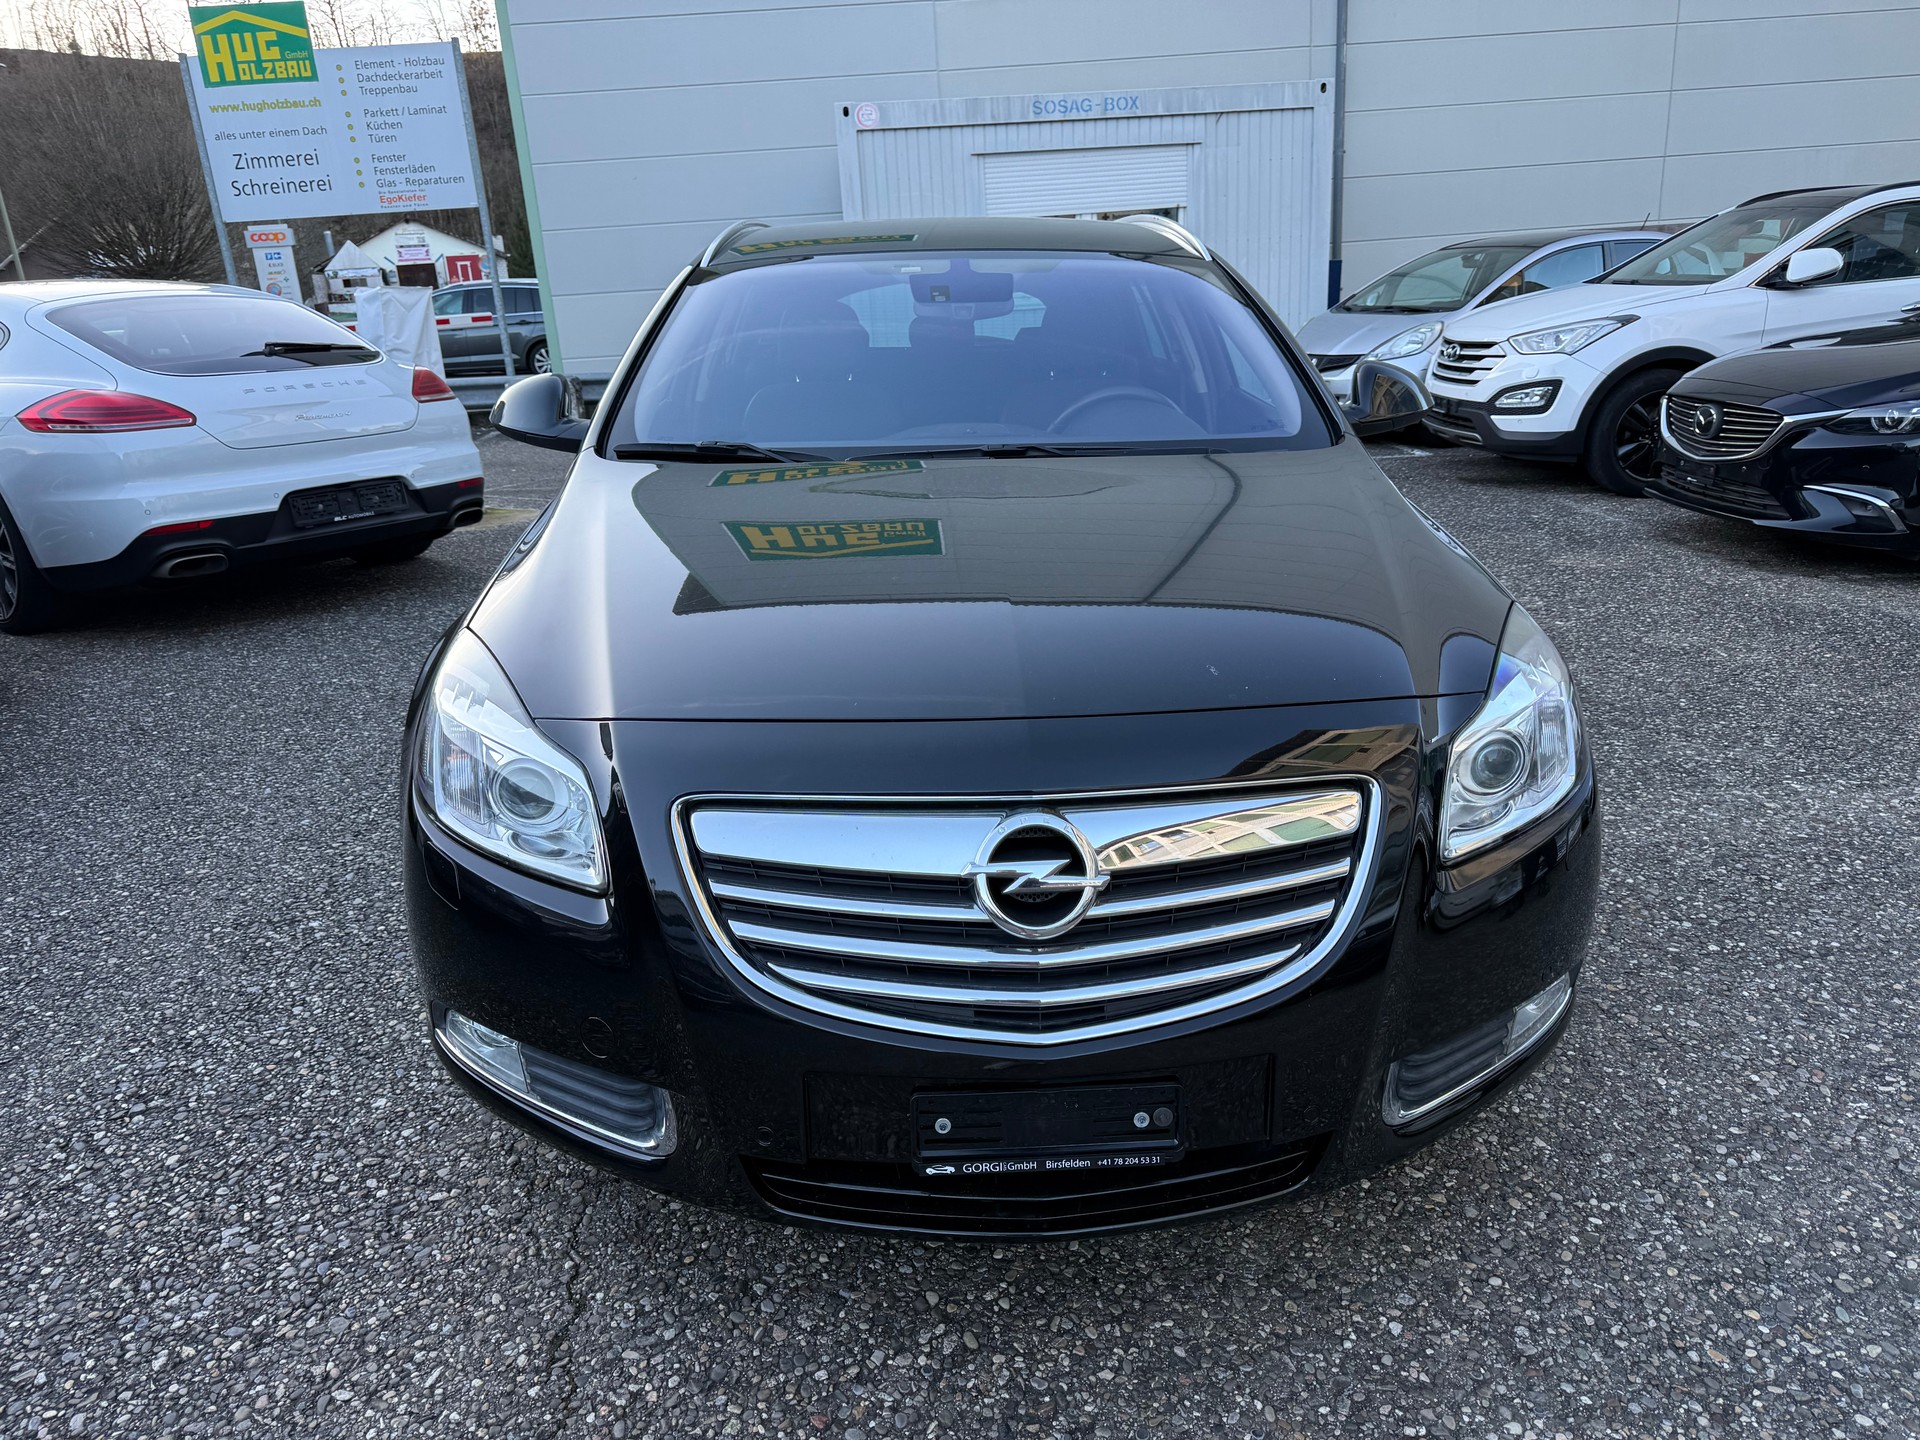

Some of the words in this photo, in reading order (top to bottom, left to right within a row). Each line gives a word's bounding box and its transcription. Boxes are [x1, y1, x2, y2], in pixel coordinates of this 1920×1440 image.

[201, 31, 281, 82] HUG
[285, 51, 308, 59] GmbH
[354, 59, 395, 70] Element
[403, 56, 445, 67] Holzbau
[356, 69, 443, 83] Dachdeckerarbeit
[359, 84, 418, 97] Treppenbau
[208, 97, 321, 113] www.hugholzbau.ch
[363, 108, 400, 118] Parkett
[407, 105, 447, 116] Laminat
[365, 120, 403, 131] Küchen
[214, 131, 237, 141] alles
[239, 130, 266, 140] unter
[269, 128, 300, 138] einem
[302, 125, 328, 136] Dach
[368, 133, 397, 143] Türen
[232, 148, 320, 170] Zimmerei
[371, 153, 406, 163] Fenster
[373, 164, 436, 176] Fensterläden
[231, 174, 333, 197] Schreinerei
[376, 178, 397, 188] Glas
[405, 175, 465, 187] Reparaturen
[379, 193, 427, 205] EgoKiefer
[250, 231, 287, 244] coop
[242, 379, 367, 395] PORSCHE
[962, 1162, 1003, 1173] GORGI
[1008, 1161, 1037, 1171] GmbH
[1046, 1159, 1091, 1169] Birsfelden
[1097, 1158, 1111, 1167] +41
[1113, 1158, 1123, 1166] 78
[1124, 1157, 1139, 1165] 204
[1140, 1156, 1150, 1164] 53
[1151, 1156, 1161, 1164] 31
